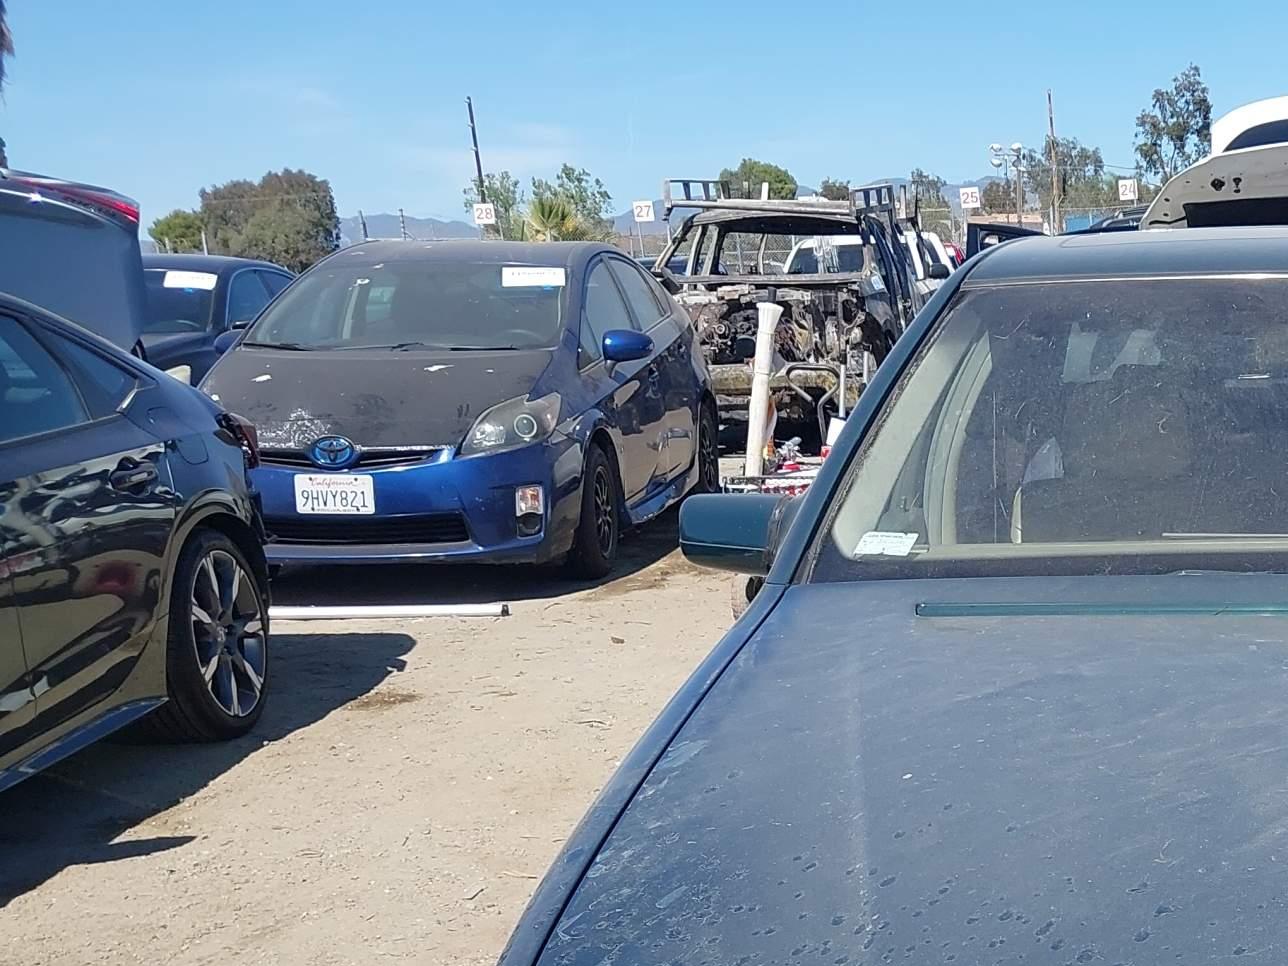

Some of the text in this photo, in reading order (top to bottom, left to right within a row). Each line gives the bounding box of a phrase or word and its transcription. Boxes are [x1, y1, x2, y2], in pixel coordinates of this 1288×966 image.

[1120, 183, 1136, 197] 24
[961, 191, 979, 204] 25
[476, 207, 493, 220] 28
[635, 205, 651, 218] 27
[311, 478, 354, 488] California
[301, 490, 368, 508] 9HVY821
